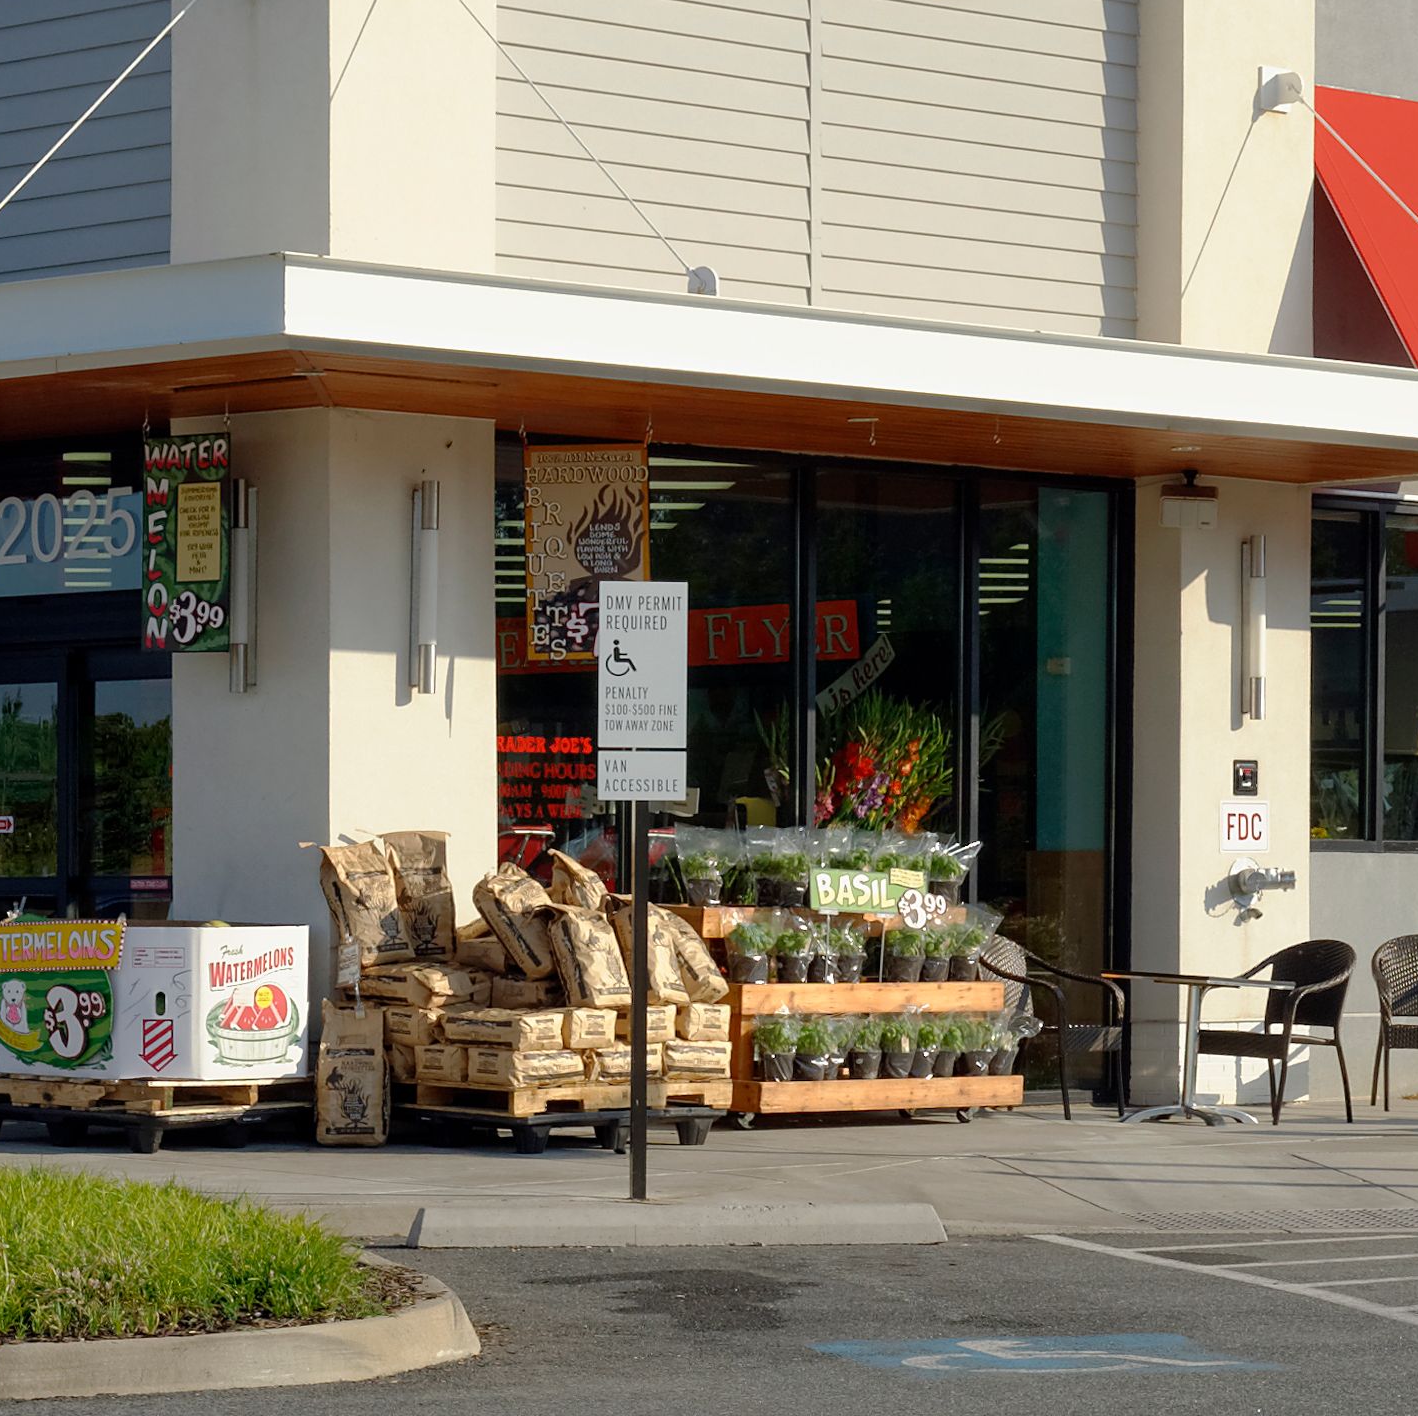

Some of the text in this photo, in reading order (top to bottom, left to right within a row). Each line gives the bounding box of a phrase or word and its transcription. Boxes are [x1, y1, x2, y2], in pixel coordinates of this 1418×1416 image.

[144, 438, 229, 472] WATER
[525, 465, 649, 484] HARDWOOD
[589, 522, 621, 531] LENDS
[576, 545, 629, 553] FLAVOR WITH
[578, 537, 629, 545] WONDERFUL
[145, 476, 170, 650] MELON
[590, 559, 613, 567] LONG
[606, 595, 682, 611] DMV PERMIT
[169, 591, 224, 644] $3.99
[606, 615, 668, 632] REQUIRED
[704, 614, 854, 660] FLYR
[605, 686, 649, 700] PENALTY
[604, 703, 678, 717] $100-$500 FINE
[605, 719, 674, 733] TOW AWAY ZONE
[498, 735, 593, 755] RADER JOE'S
[543, 762, 597, 780] HOURS
[605, 759, 627, 773] VAN
[604, 779, 678, 793] ACCESSIBLE
[536, 803, 544, 818] A
[1227, 812, 1262, 841] FDC
[815, 871, 896, 910] BASIL
[897, 889, 947, 930] $3.99
[220, 944, 244, 959] Fresh
[208, 946, 294, 988] WATERMELONS
[44, 985, 104, 1058] $3.99
